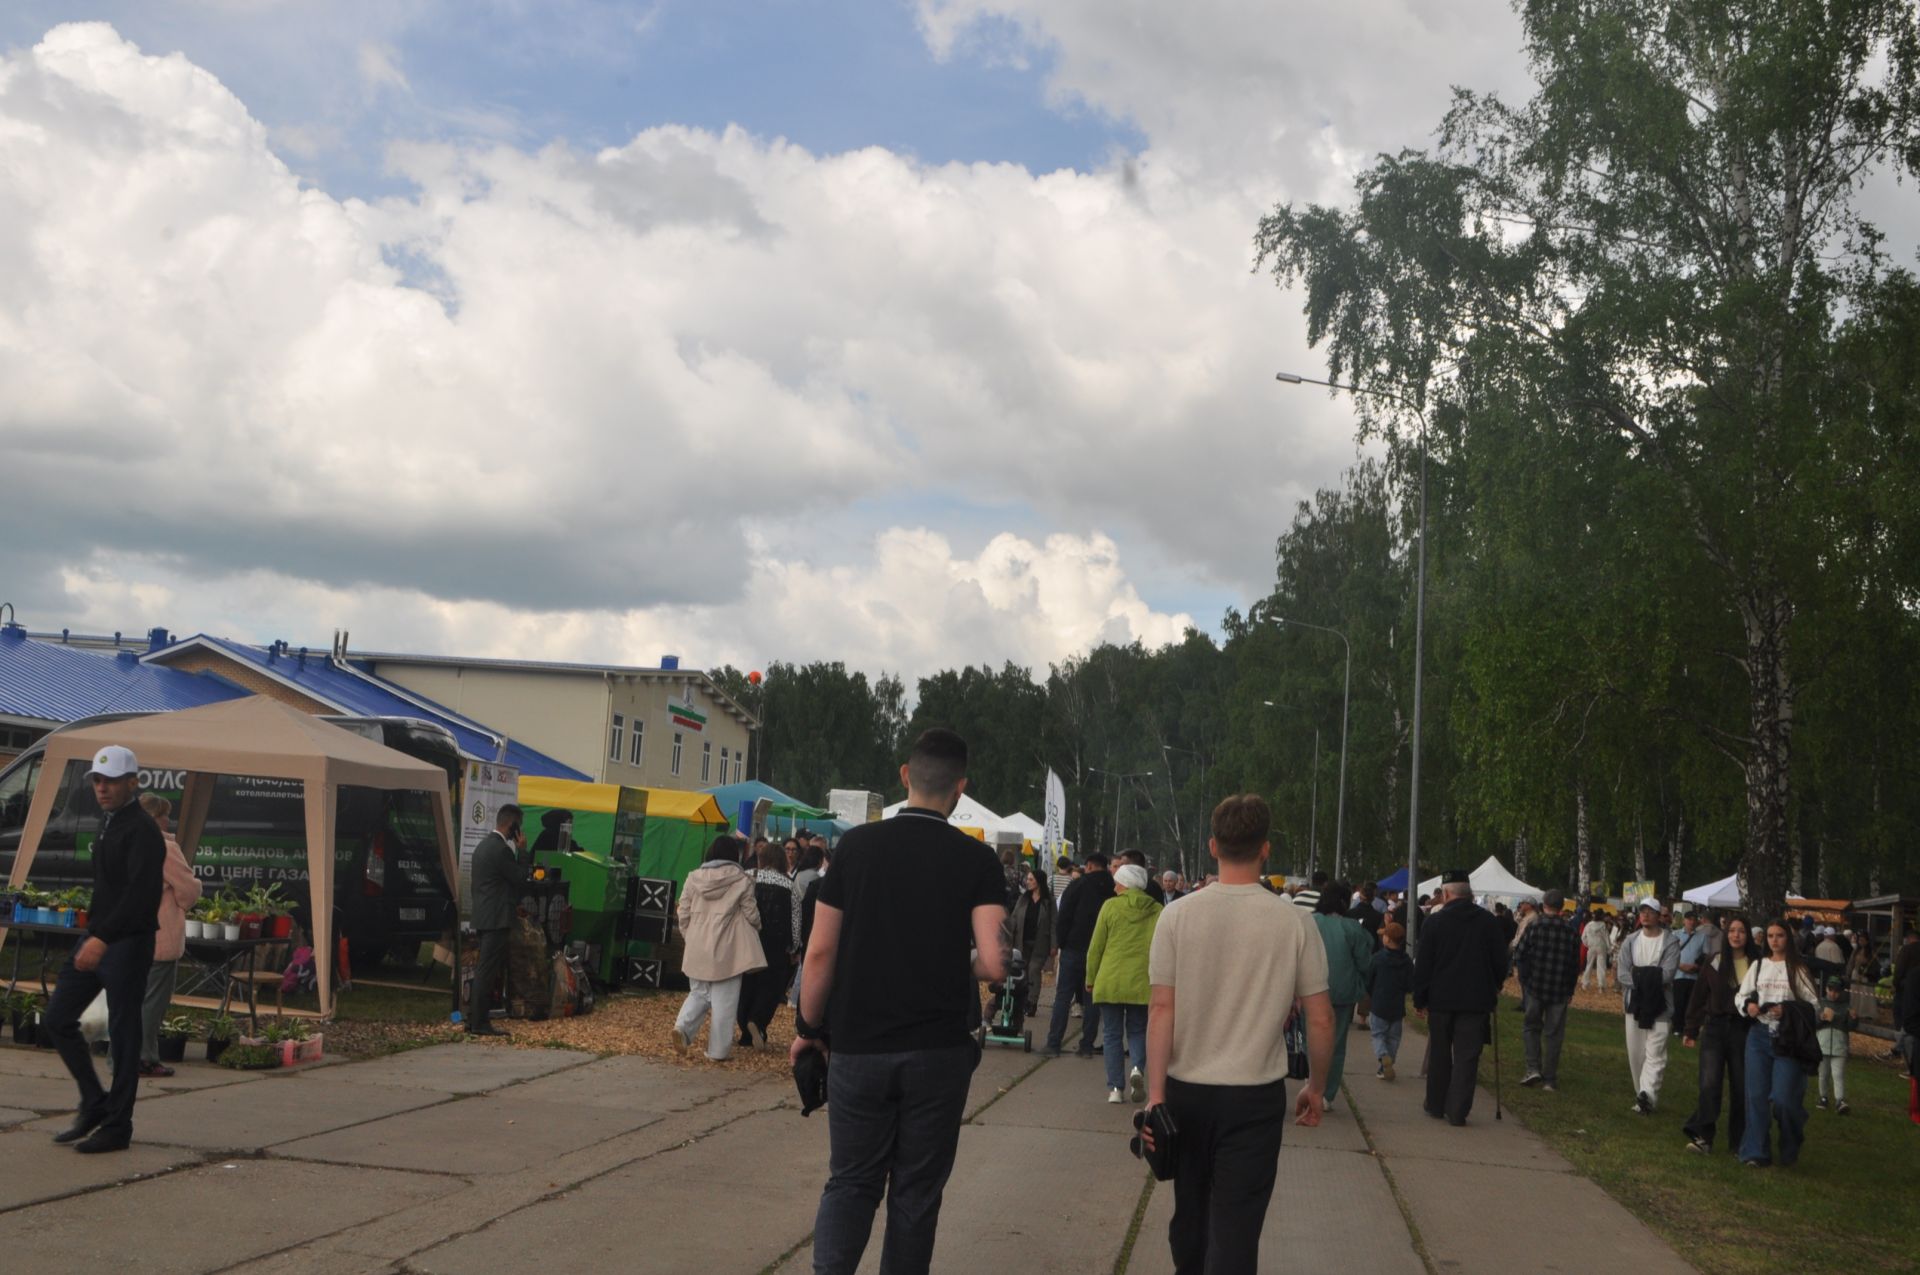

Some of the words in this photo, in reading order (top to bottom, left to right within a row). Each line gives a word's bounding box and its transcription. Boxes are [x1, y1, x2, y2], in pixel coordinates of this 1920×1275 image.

[221, 846, 289, 860] СКЛАДОВ,
[220, 865, 264, 881] ЦЕНЕ
[268, 868, 309, 880] ГАЗА
